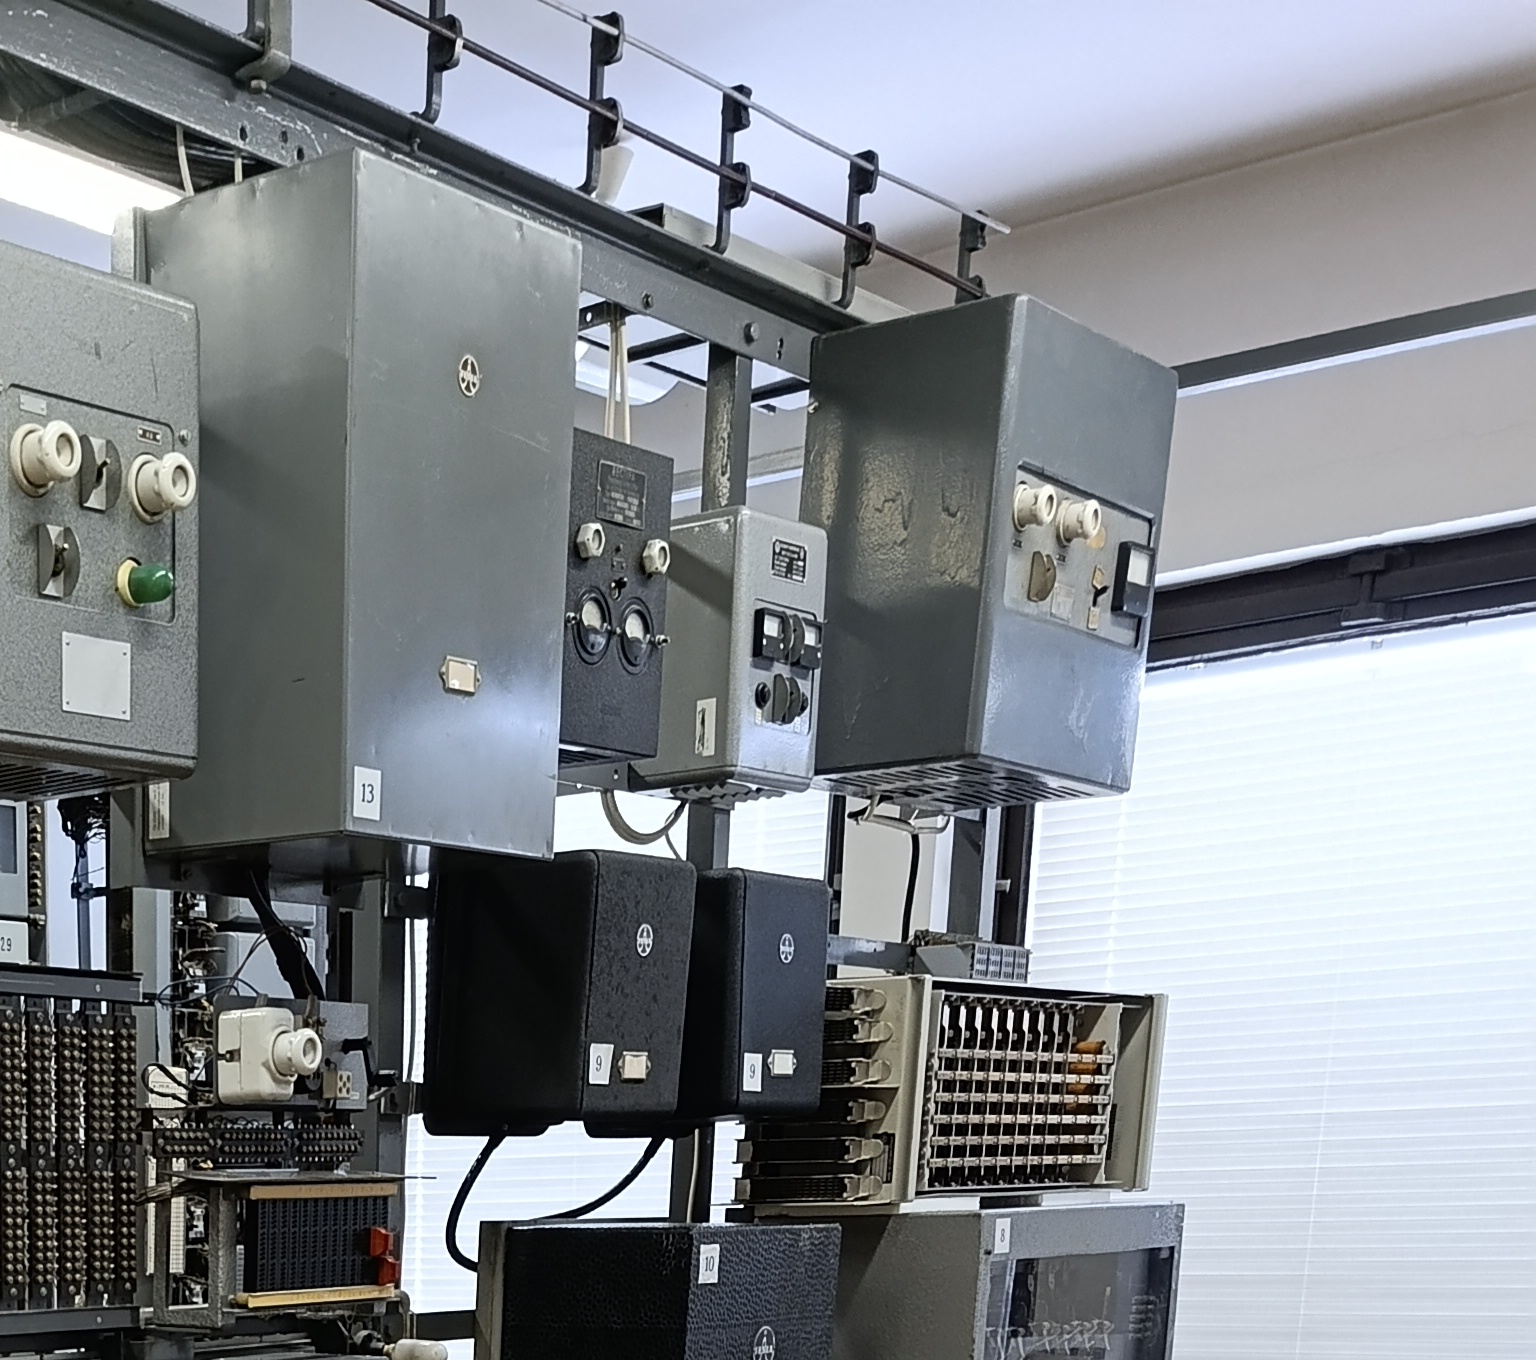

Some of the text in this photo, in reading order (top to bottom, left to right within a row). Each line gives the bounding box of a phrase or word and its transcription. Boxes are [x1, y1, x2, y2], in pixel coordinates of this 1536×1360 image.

[361, 783, 374, 803] 13
[595, 1055, 603, 1072] 9
[749, 1064, 756, 1080] 9
[1000, 1228, 1006, 1243] 8
[704, 1256, 714, 1272] 10
